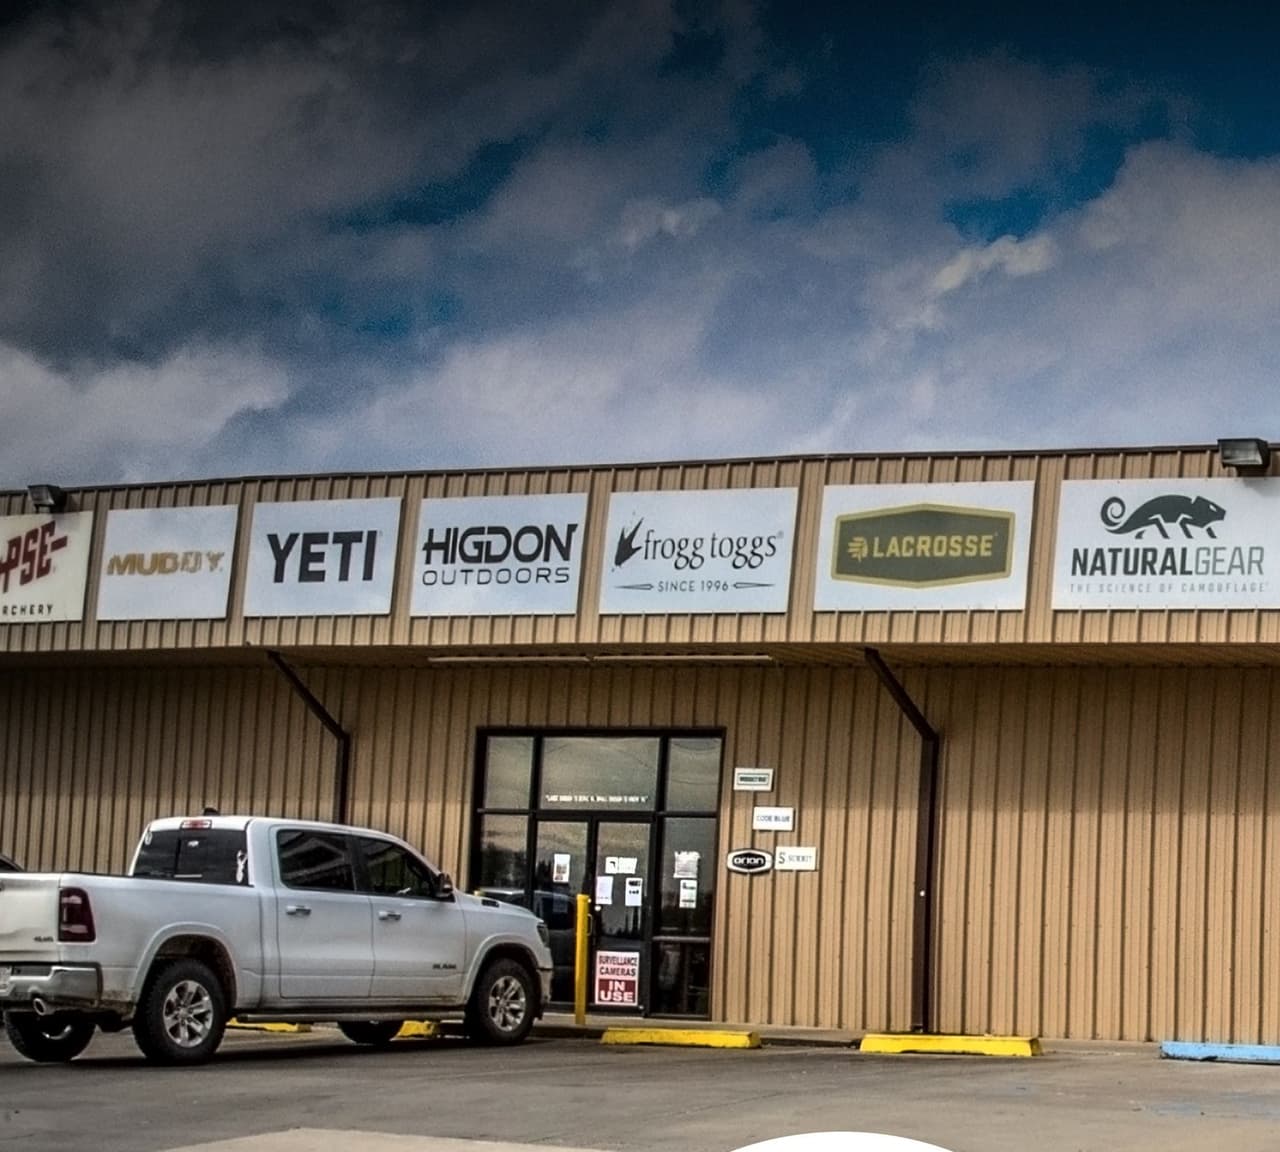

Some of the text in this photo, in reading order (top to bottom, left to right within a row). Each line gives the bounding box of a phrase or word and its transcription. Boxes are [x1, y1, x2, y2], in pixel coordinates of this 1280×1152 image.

[422, 524, 578, 565] HIGDON
[644, 529, 777, 570] frogg toggs
[873, 533, 993, 557] LACROSSE
[107, 551, 224, 576] MUDDY
[267, 530, 378, 583] YETI
[423, 567, 571, 586] OUTDOORS
[657, 580, 729, 592] SINCE 1996
[1070, 583, 1090, 593] THE
[1100, 583, 1150, 592] SCIENCE
[1159, 583, 1173, 592] OF
[1, 603, 54, 617] RCHERY
[600, 966, 636, 977] CAMERAS
[609, 980, 625, 991] IN
[600, 990, 634, 1002] USE
